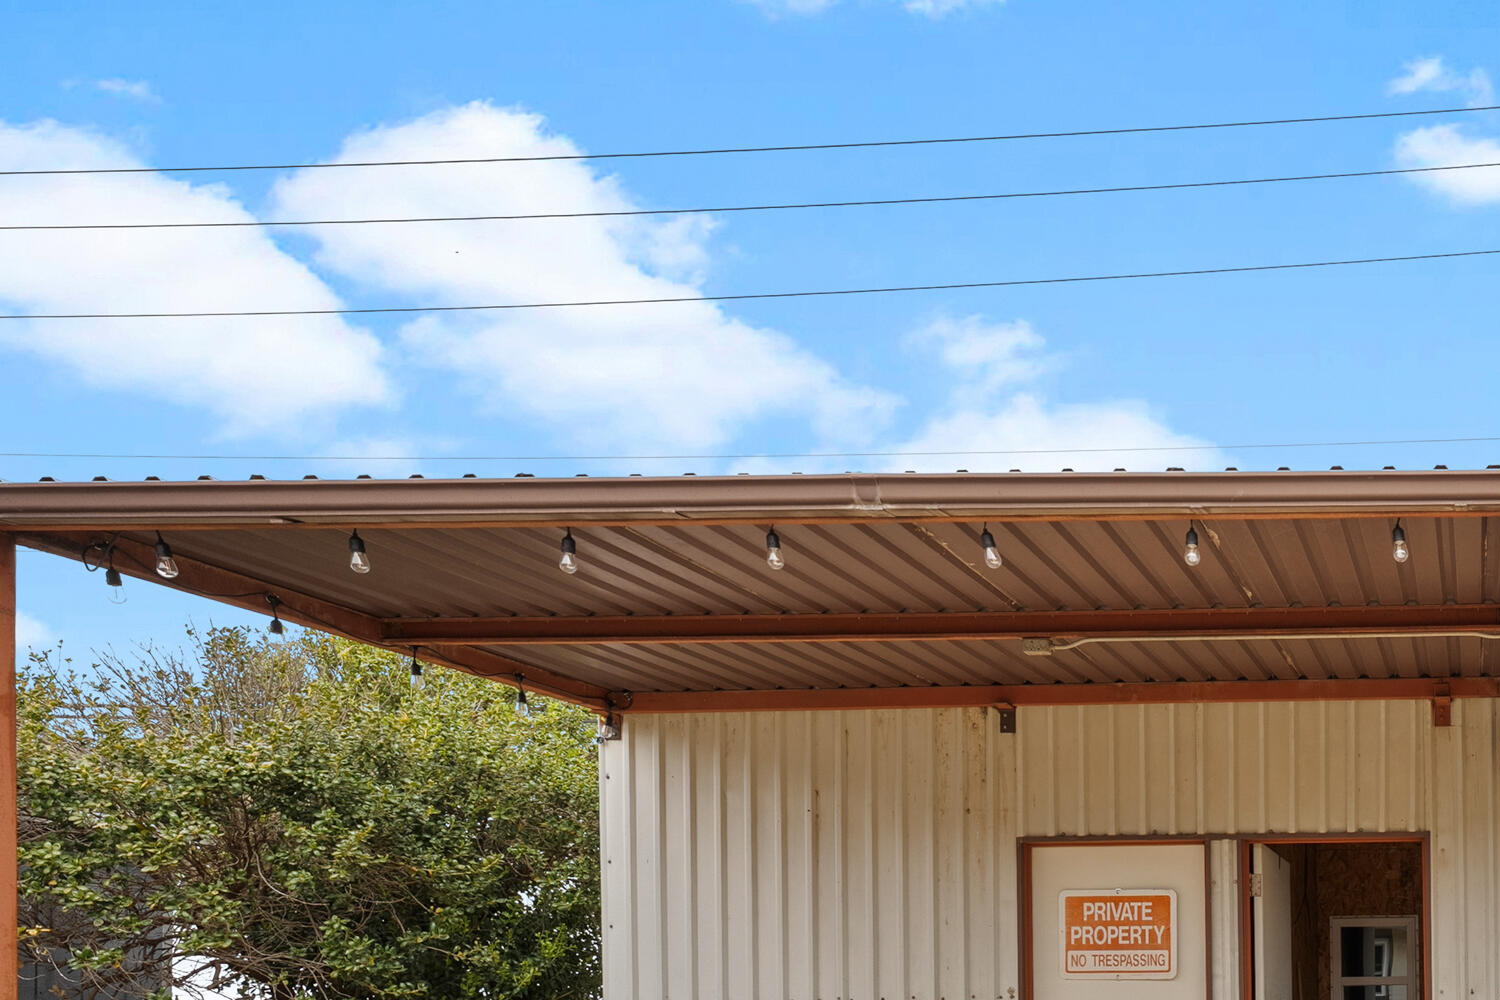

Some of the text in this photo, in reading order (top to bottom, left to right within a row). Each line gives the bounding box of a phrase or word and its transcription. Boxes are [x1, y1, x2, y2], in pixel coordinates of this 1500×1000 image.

[1083, 902, 1153, 921] PRIVATE
[1070, 925, 1165, 945] PROPERTY
[1070, 953, 1166, 968] NO TRESPASSING
